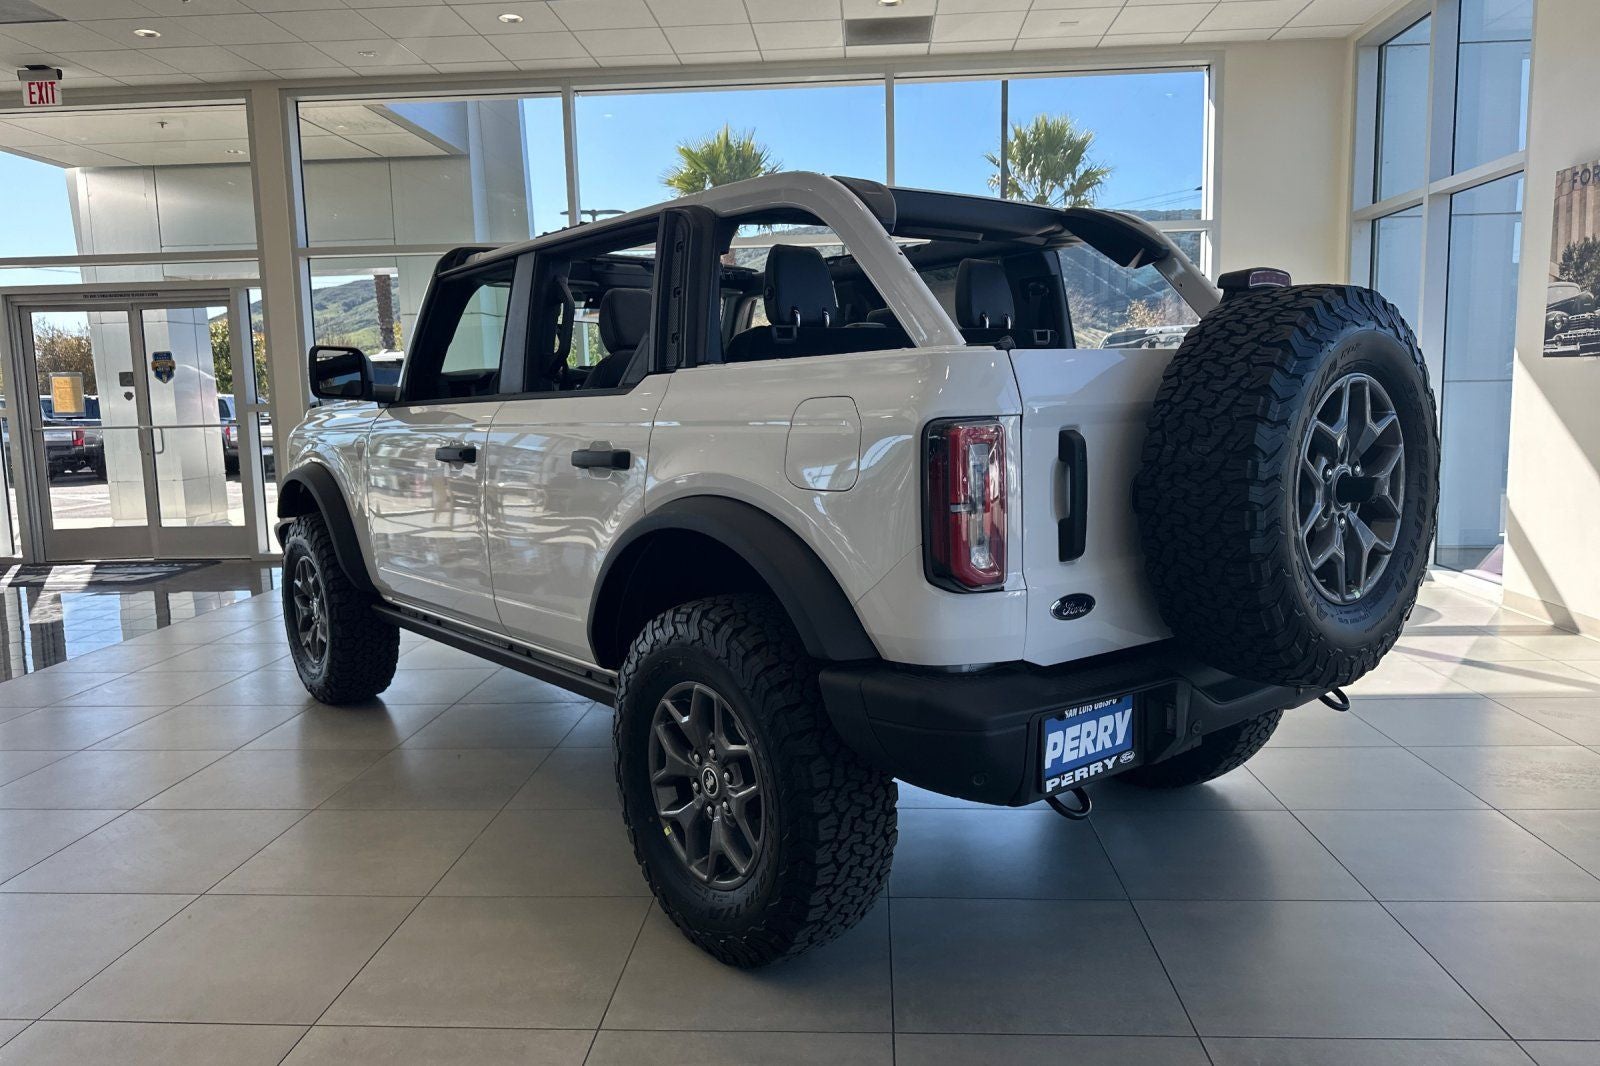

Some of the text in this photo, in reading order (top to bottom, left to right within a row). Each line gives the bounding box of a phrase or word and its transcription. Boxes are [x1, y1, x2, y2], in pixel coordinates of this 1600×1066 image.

[28, 81, 56, 104] EXIT
[1064, 707, 1078, 719] SAN
[1045, 707, 1133, 770] PERRY
[1046, 755, 1118, 793] PERRY
